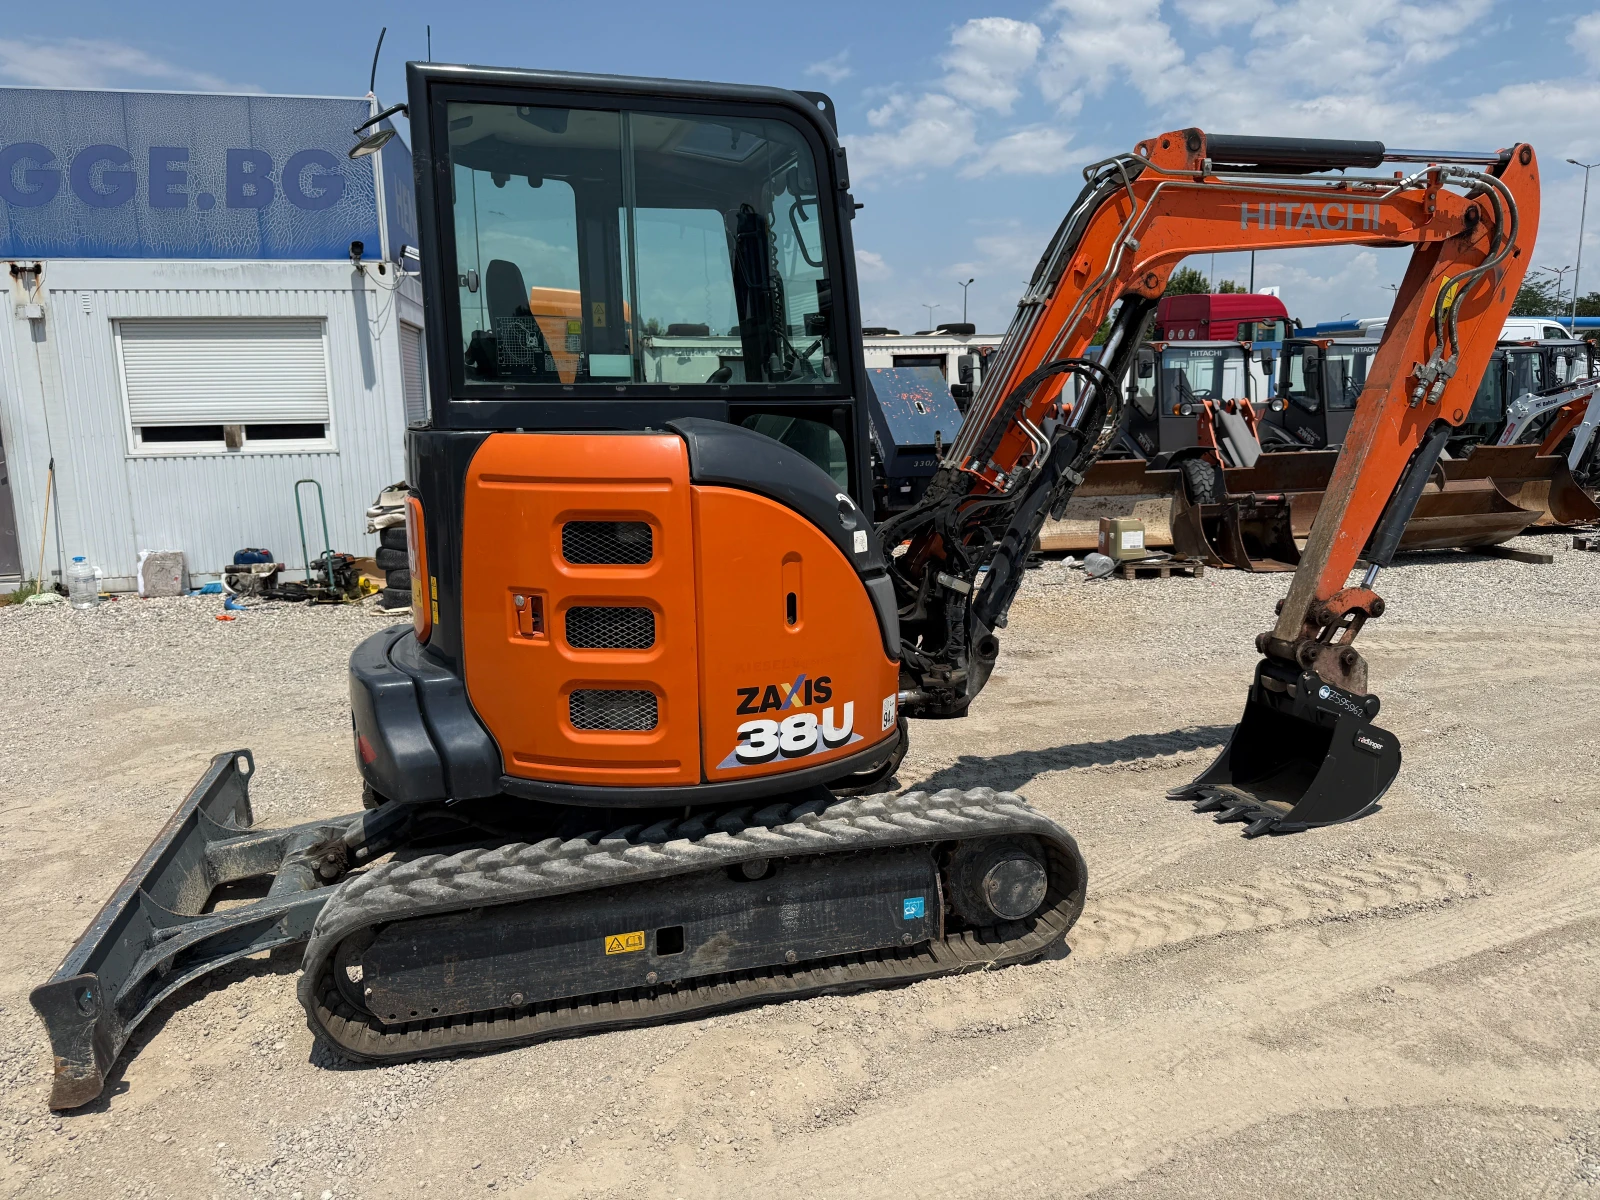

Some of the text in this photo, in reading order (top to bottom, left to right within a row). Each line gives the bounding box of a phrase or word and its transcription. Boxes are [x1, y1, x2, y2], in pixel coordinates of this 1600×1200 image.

[1240, 202, 1381, 230] HITACHI
[736, 674, 833, 716] ZAXIS
[735, 700, 854, 765] 38U
